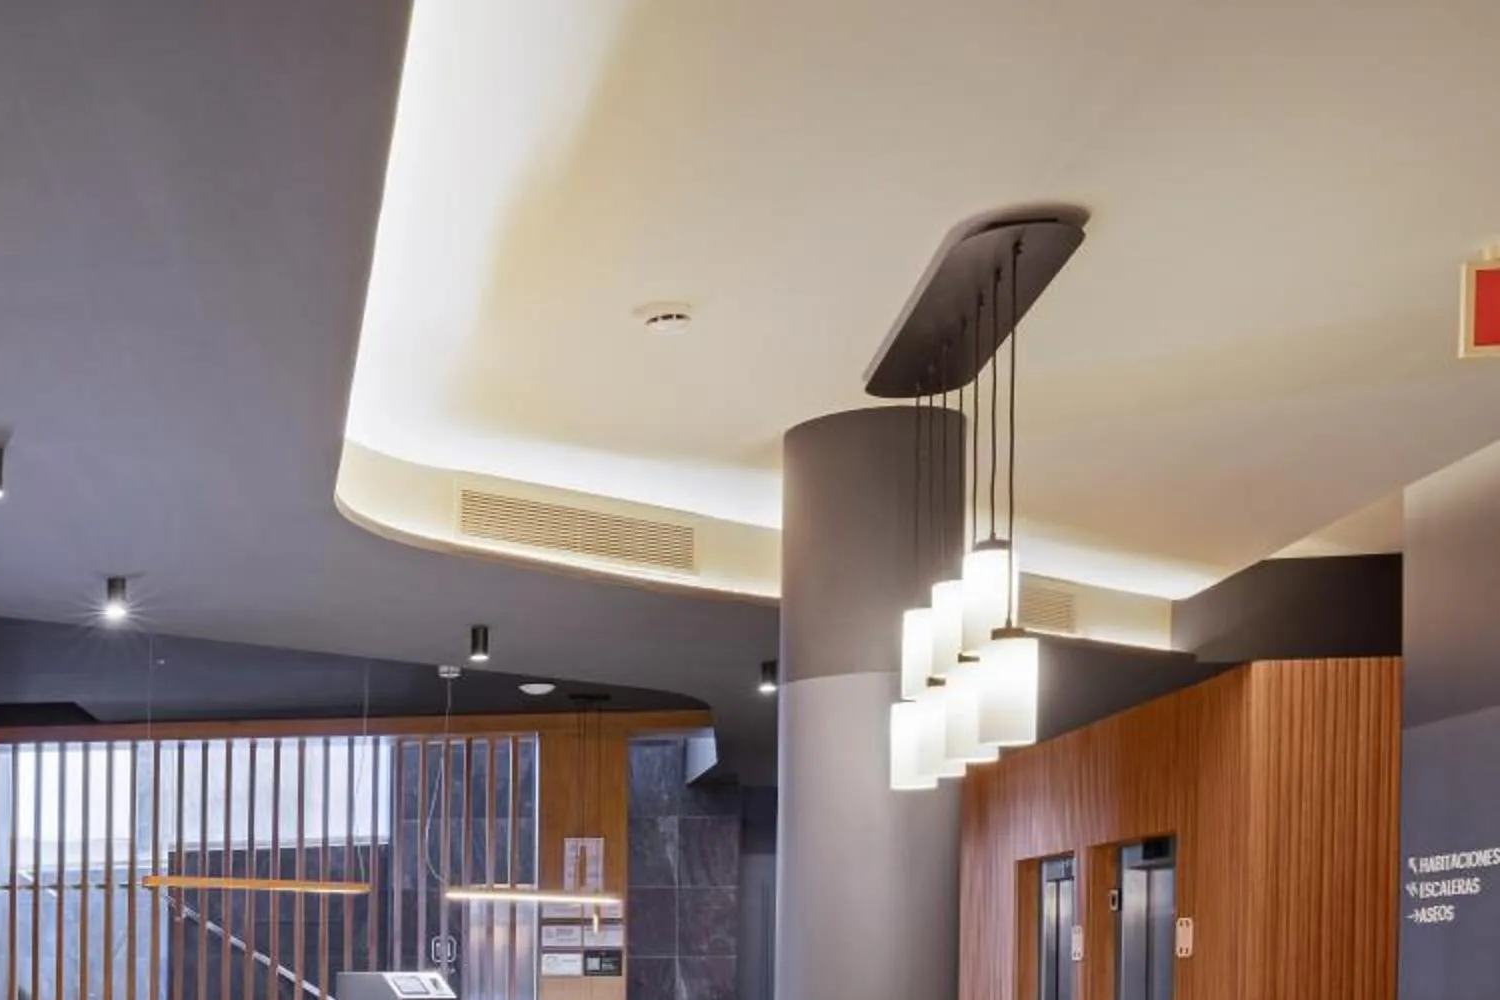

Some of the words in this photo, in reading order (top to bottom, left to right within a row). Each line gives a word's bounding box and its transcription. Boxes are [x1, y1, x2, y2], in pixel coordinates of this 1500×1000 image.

[1419, 847, 1500, 873] HABITACIONES
[1419, 877, 1481, 898] ESCALERAS
[1419, 904, 1455, 923] ASEOS
